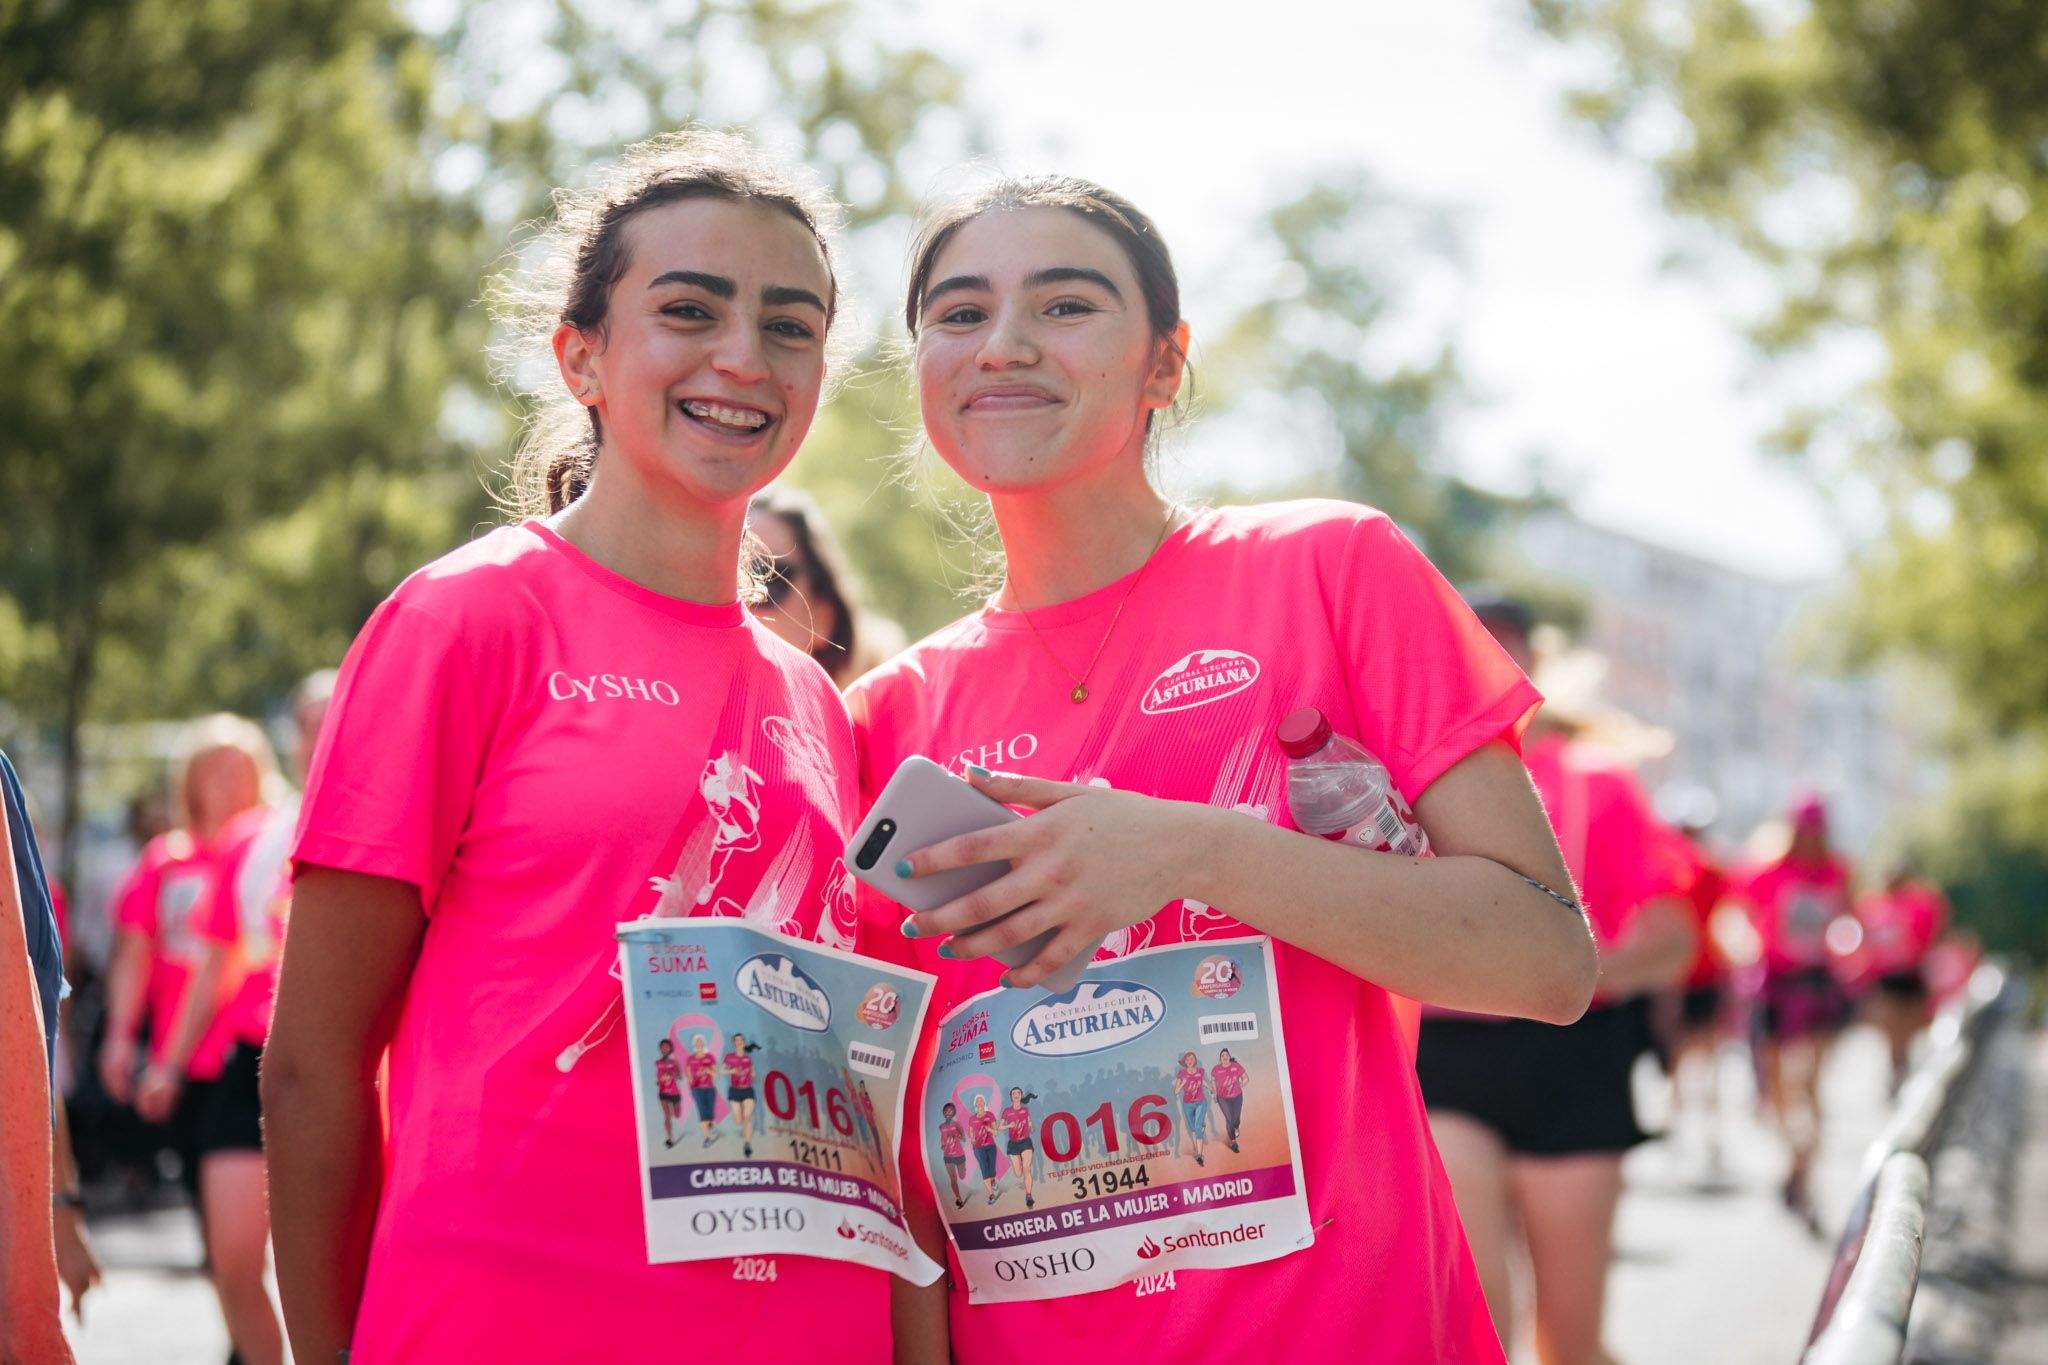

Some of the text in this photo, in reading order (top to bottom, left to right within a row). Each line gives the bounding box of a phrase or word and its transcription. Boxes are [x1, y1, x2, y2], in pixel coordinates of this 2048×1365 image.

[548, 671, 680, 705] OYSHO
[1149, 667, 1251, 710] ASTURIANA
[648, 956, 708, 973] SUMA
[1200, 960, 1233, 984] 20
[866, 988, 898, 1014] 20
[1044, 994, 1148, 1021] CENTRAL LECHERA
[948, 1020, 988, 1052] SUMA
[1023, 1004, 1155, 1048] ASTURIANA
[764, 1070, 854, 1137] 016
[1040, 1094, 1172, 1162] 016
[789, 1140, 842, 1172] 12111
[690, 1167, 775, 1188] CARRERA
[778, 1168, 799, 1186] DE
[800, 1171, 817, 1190] LA
[817, 1176, 862, 1199] MUJER
[1071, 1164, 1150, 1199] 31944
[692, 1206, 805, 1236] OYSHO
[983, 1178, 1253, 1241] CARRERA DE LA MUJER MADRID
[995, 1224, 1265, 1281] OYSHO Santander
[732, 1257, 777, 1282] 2024
[1133, 1270, 1176, 1297] 2024
